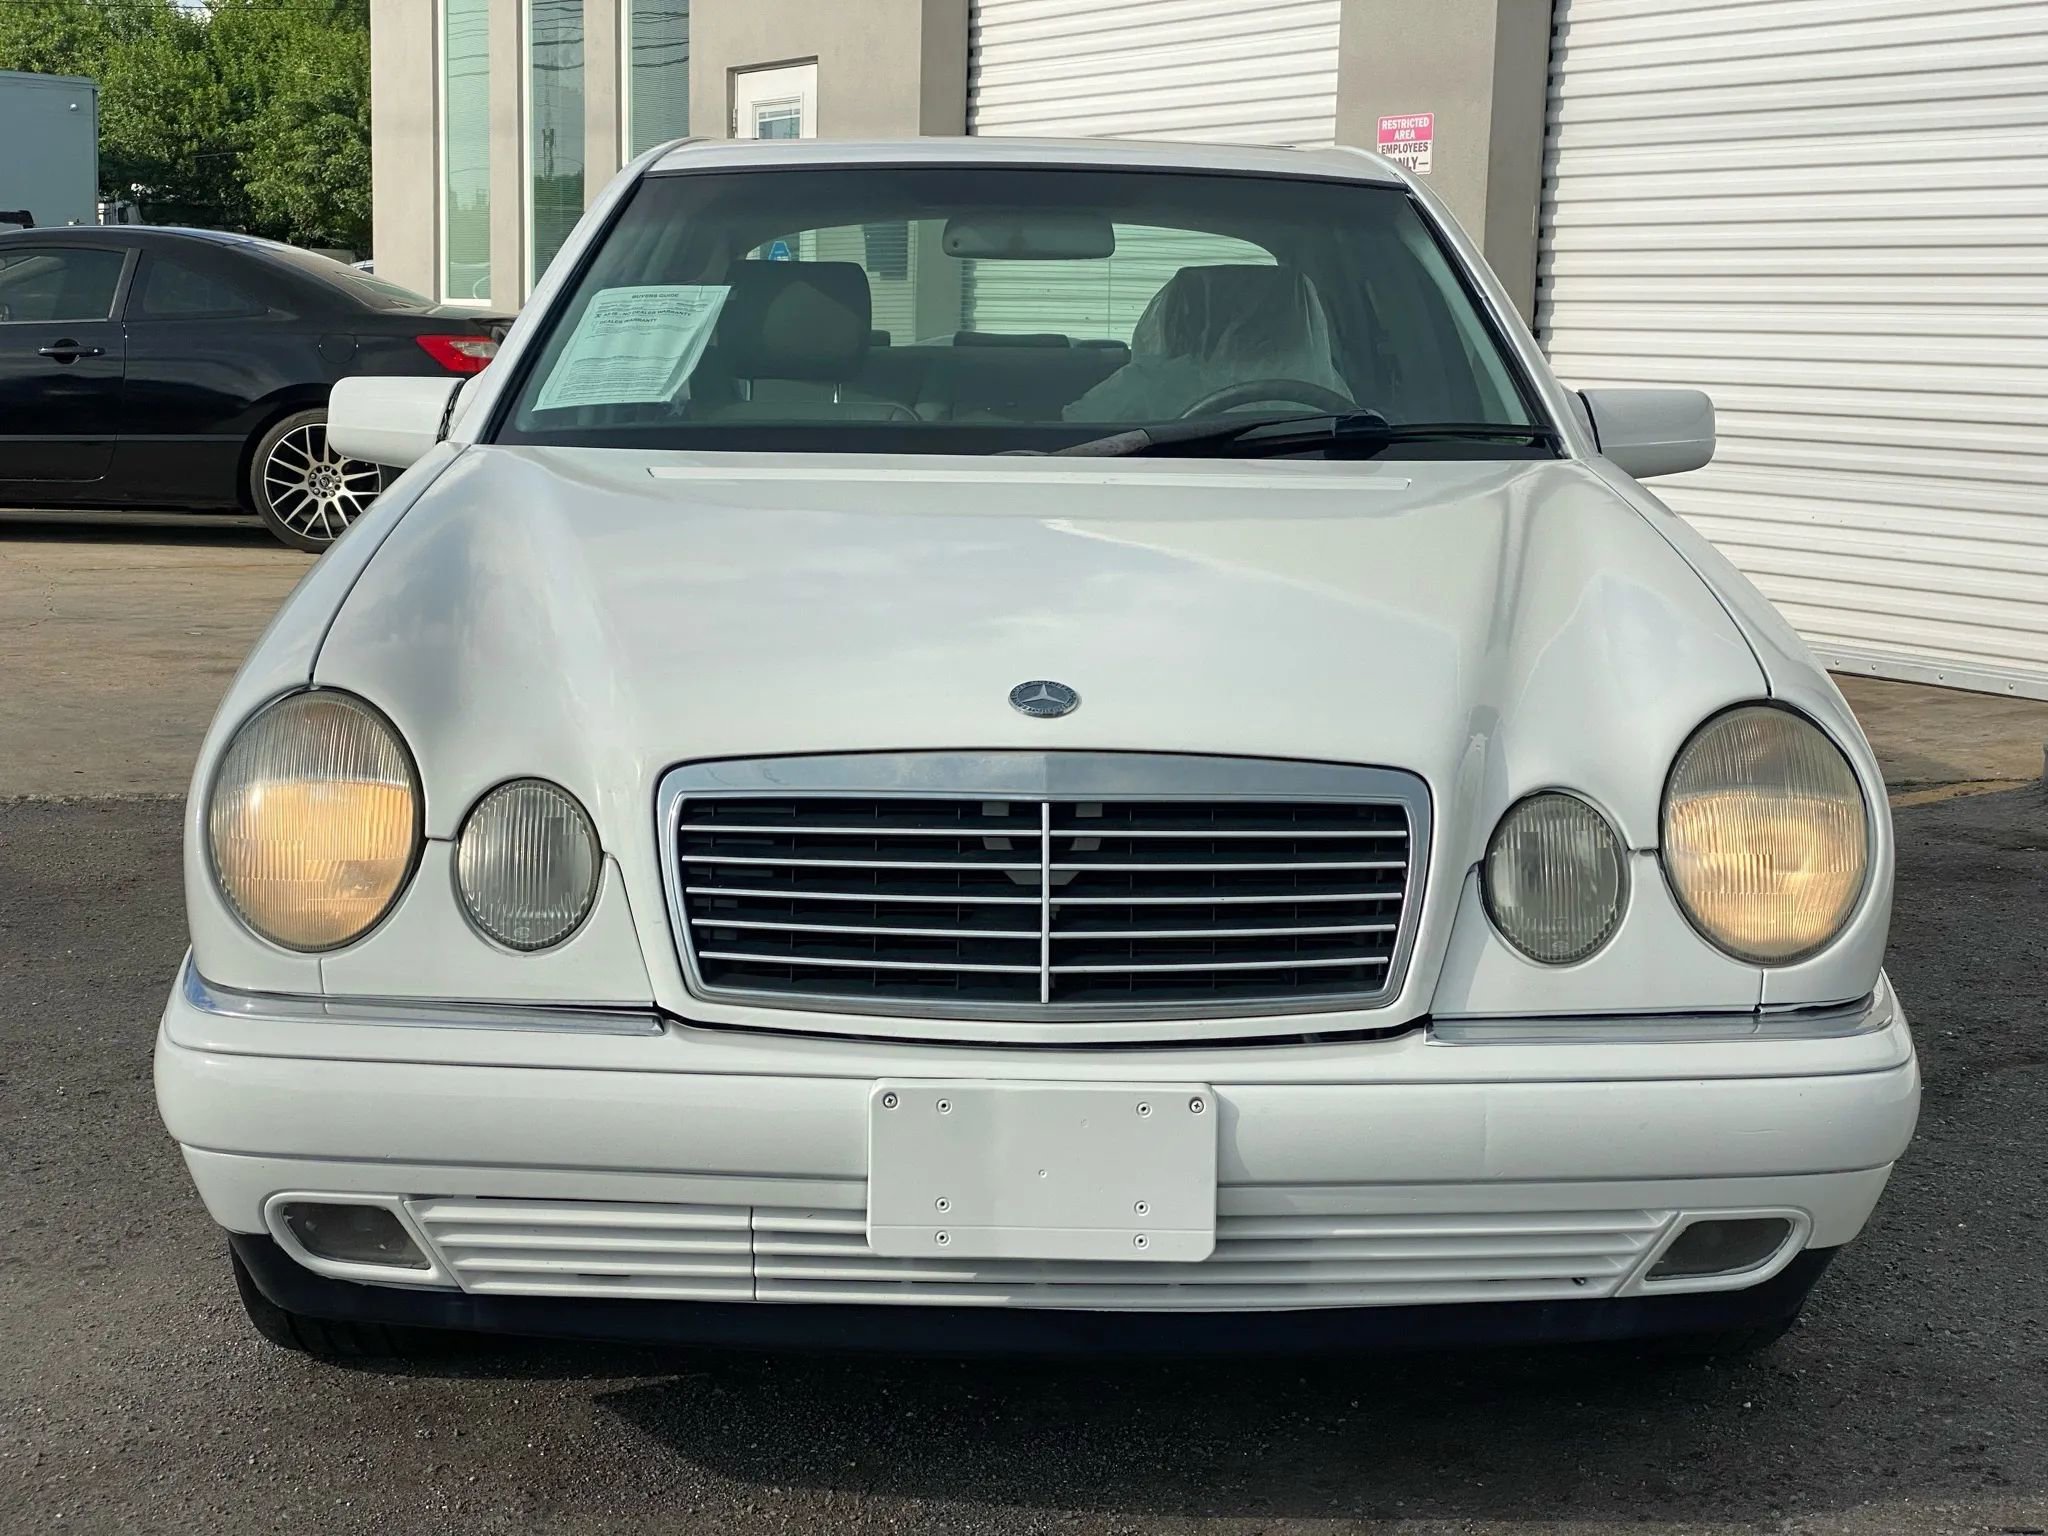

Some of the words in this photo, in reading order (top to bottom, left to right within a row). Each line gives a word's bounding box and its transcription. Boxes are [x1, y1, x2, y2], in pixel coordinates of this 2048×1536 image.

[1382, 117, 1429, 130] RESTRICTED
[1394, 129, 1415, 140] AREA
[1382, 142, 1428, 154] EMPLOYEES
